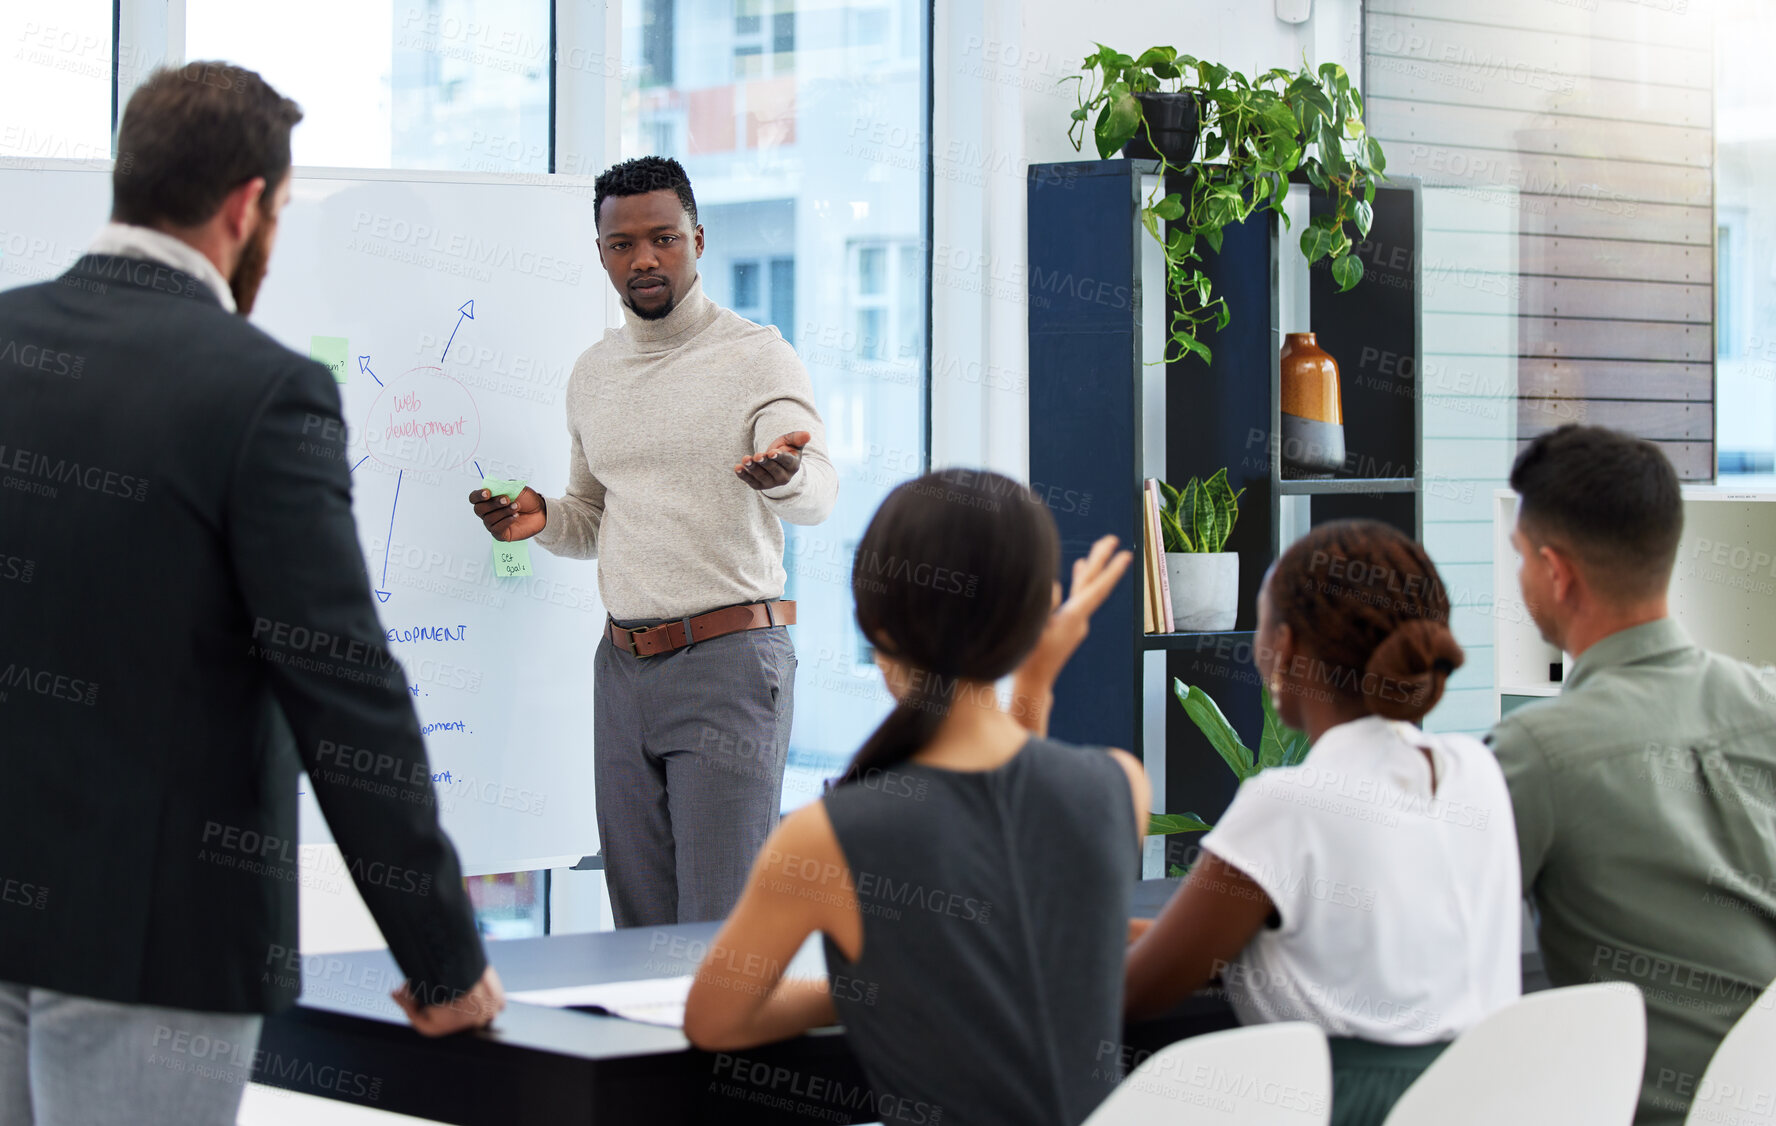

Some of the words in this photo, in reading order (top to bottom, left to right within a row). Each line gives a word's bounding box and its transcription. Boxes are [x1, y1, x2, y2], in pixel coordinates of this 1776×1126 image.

[394, 391, 421, 412] web
[386, 412, 467, 444] development
[384, 624, 467, 644] ELOPMENT
